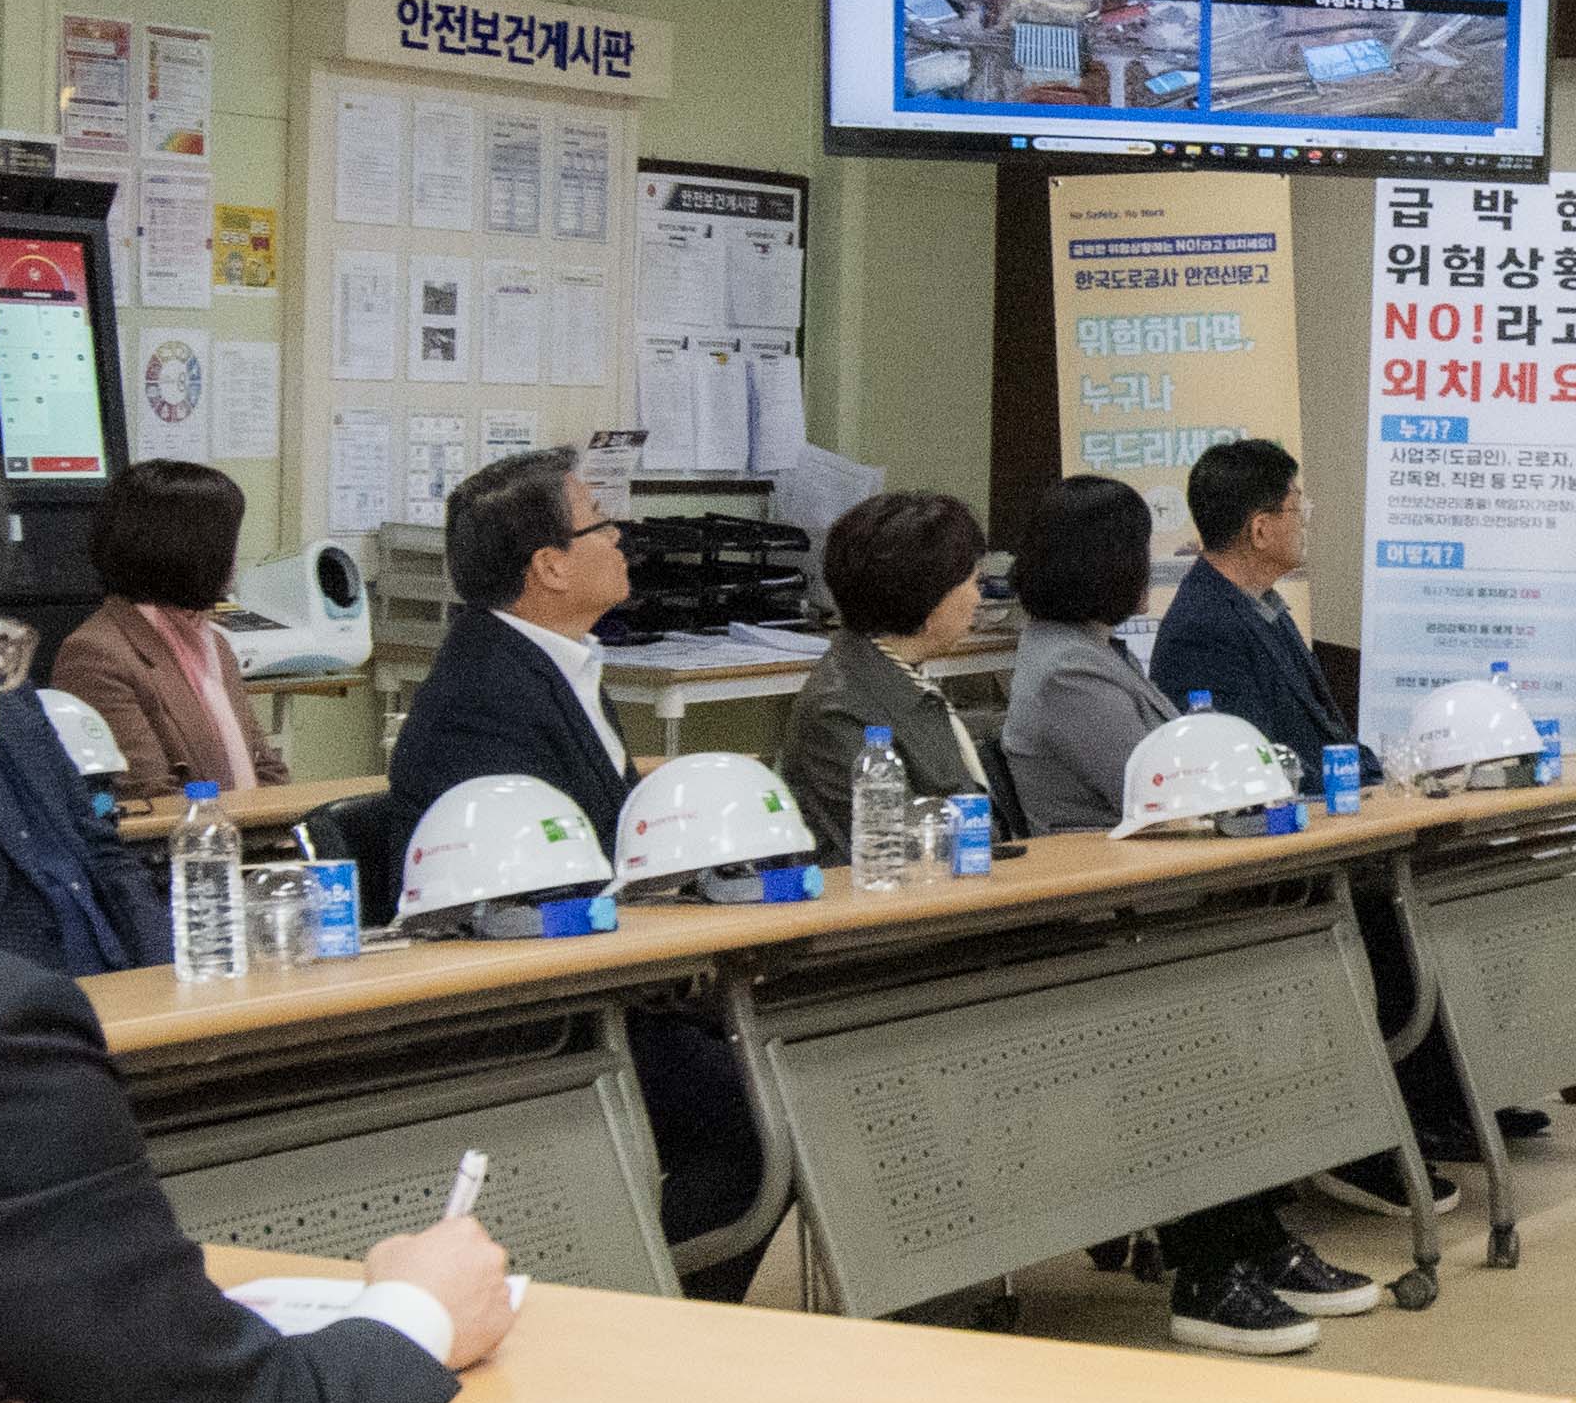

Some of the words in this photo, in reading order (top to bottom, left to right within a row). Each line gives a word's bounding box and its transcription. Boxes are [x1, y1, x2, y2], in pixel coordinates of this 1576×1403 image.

[1075, 267, 1178, 291] 한국도로공사
[1184, 264, 1270, 287] 안전신문고
[1080, 373, 1174, 414] 누구나
[1080, 427, 1249, 471] 두드리세
[1511, 473, 1544, 489] 모두
